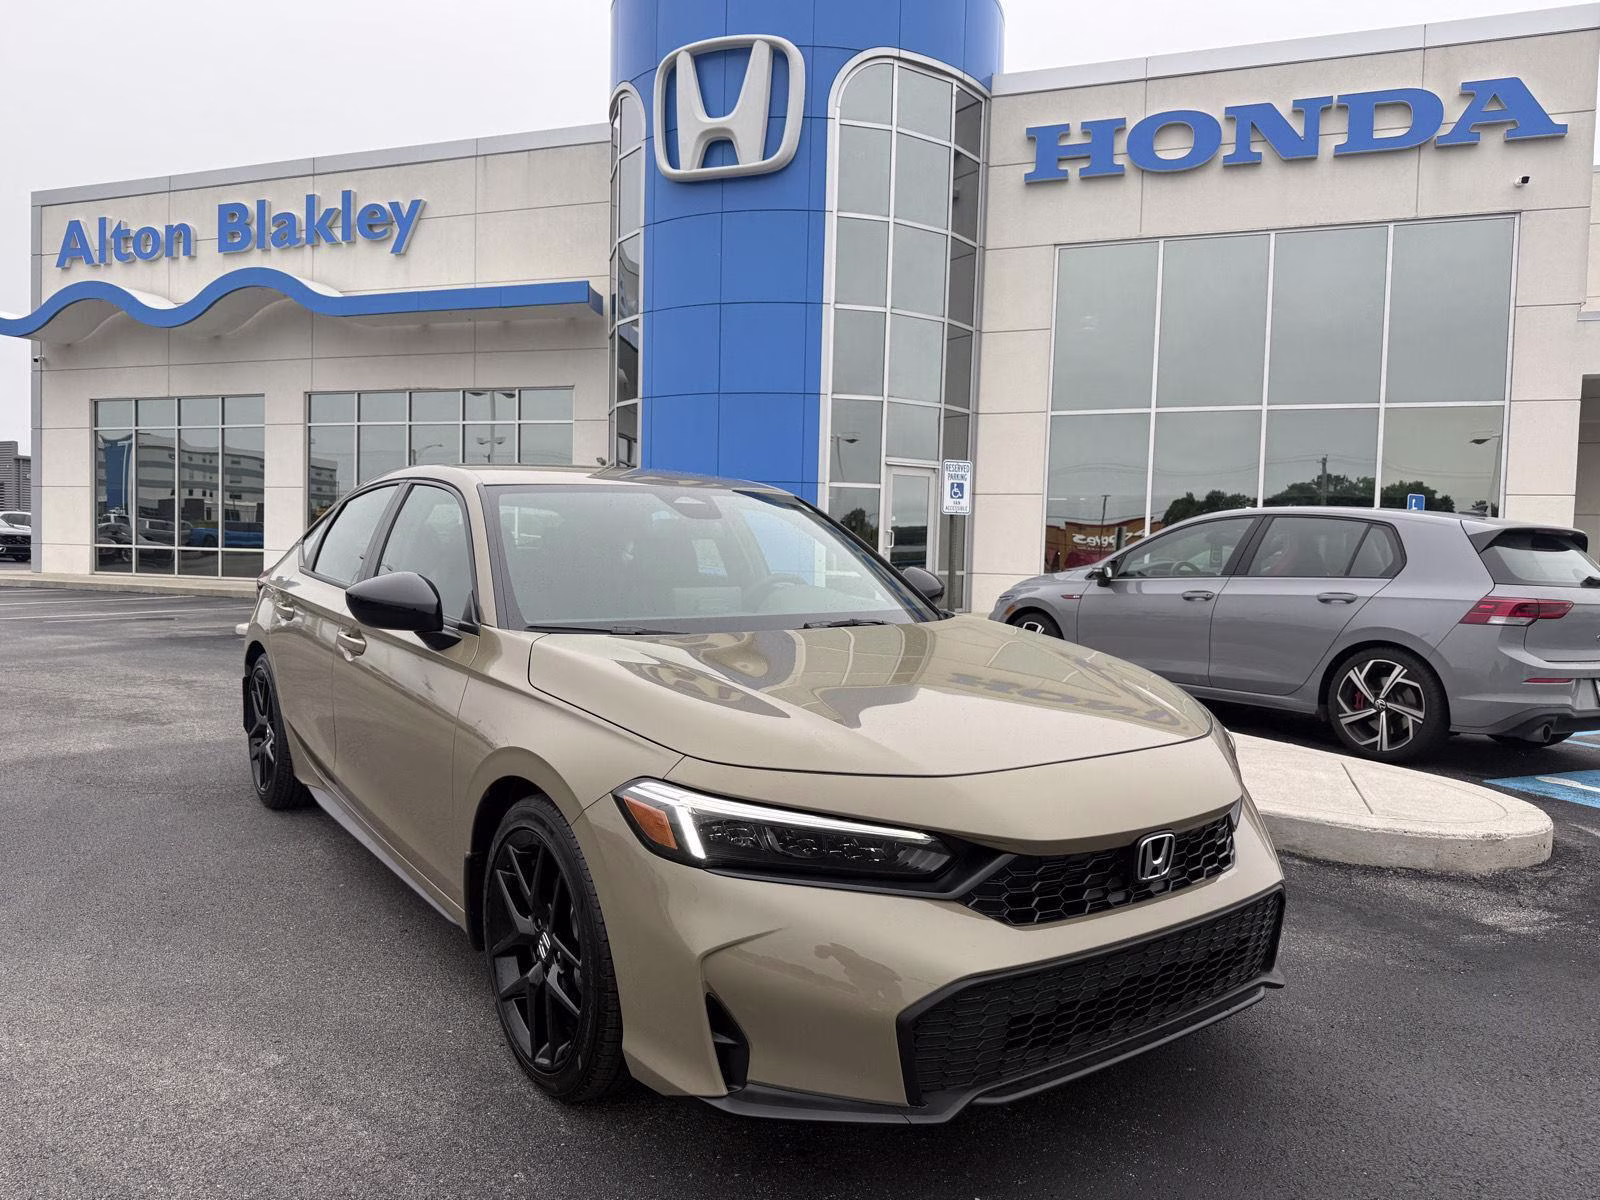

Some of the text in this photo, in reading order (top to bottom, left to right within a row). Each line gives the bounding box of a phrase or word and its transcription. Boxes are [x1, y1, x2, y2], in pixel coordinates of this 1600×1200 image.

[1024, 76, 1568, 184] HONDA
[55, 189, 426, 270] Alton Blakley
[945, 463, 970, 473] RESERVED
[947, 472, 968, 481] PARKING
